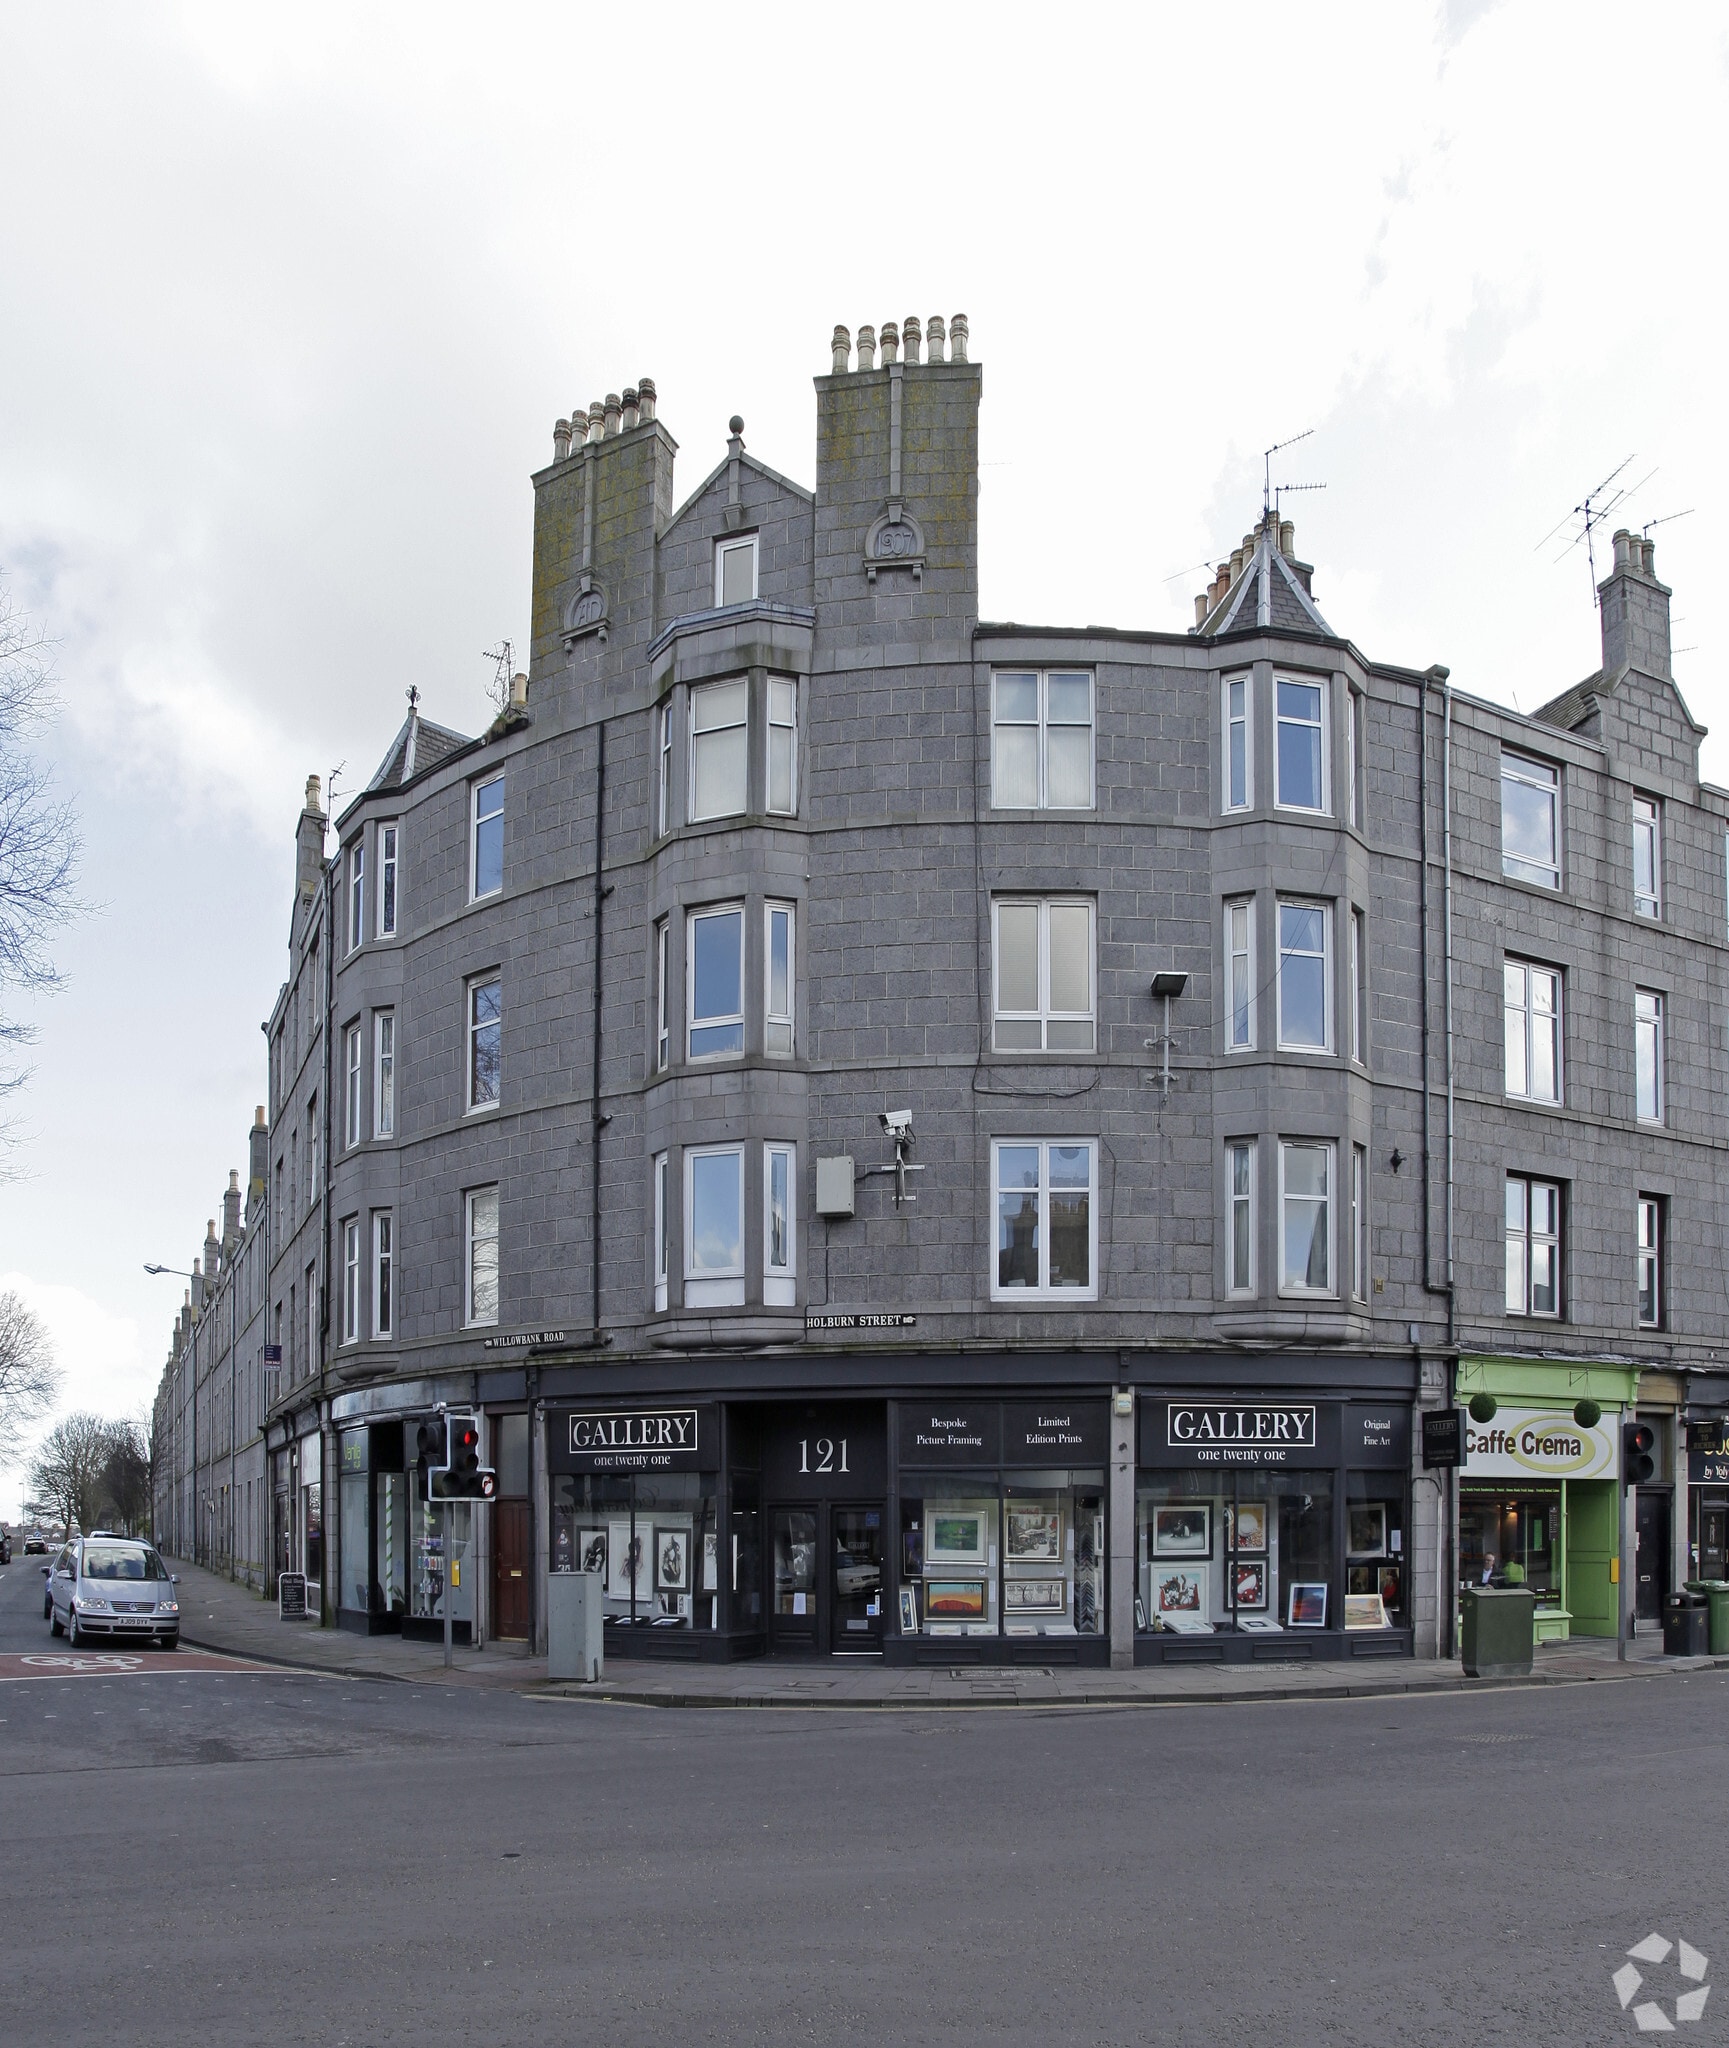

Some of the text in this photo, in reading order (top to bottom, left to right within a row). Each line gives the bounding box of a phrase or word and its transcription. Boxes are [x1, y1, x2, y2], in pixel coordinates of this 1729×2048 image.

[876, 531, 913, 557] 1907
[806, 1314, 901, 1328] HOLBURN STREET
[493, 1331, 565, 1347] WILLOWBANK ROAD
[931, 1417, 967, 1429] Bespoke
[1038, 1416, 1070, 1427] Limited
[1173, 1411, 1311, 1440] GALLERY
[1363, 1419, 1391, 1431] Original
[1426, 1421, 1456, 1432] GALLERY
[573, 1417, 691, 1447] GALLERY
[1026, 1433, 1083, 1444] Edition Prints
[916, 1434, 982, 1446] Picture Framing
[1363, 1435, 1391, 1446] Fine Art
[1466, 1429, 1581, 1456] Caffe Crema
[594, 1453, 671, 1468] one twenty one
[798, 1438, 851, 1473] 121
[1197, 1449, 1286, 1463] one twenty one
[1703, 1465, 1713, 1479] by
